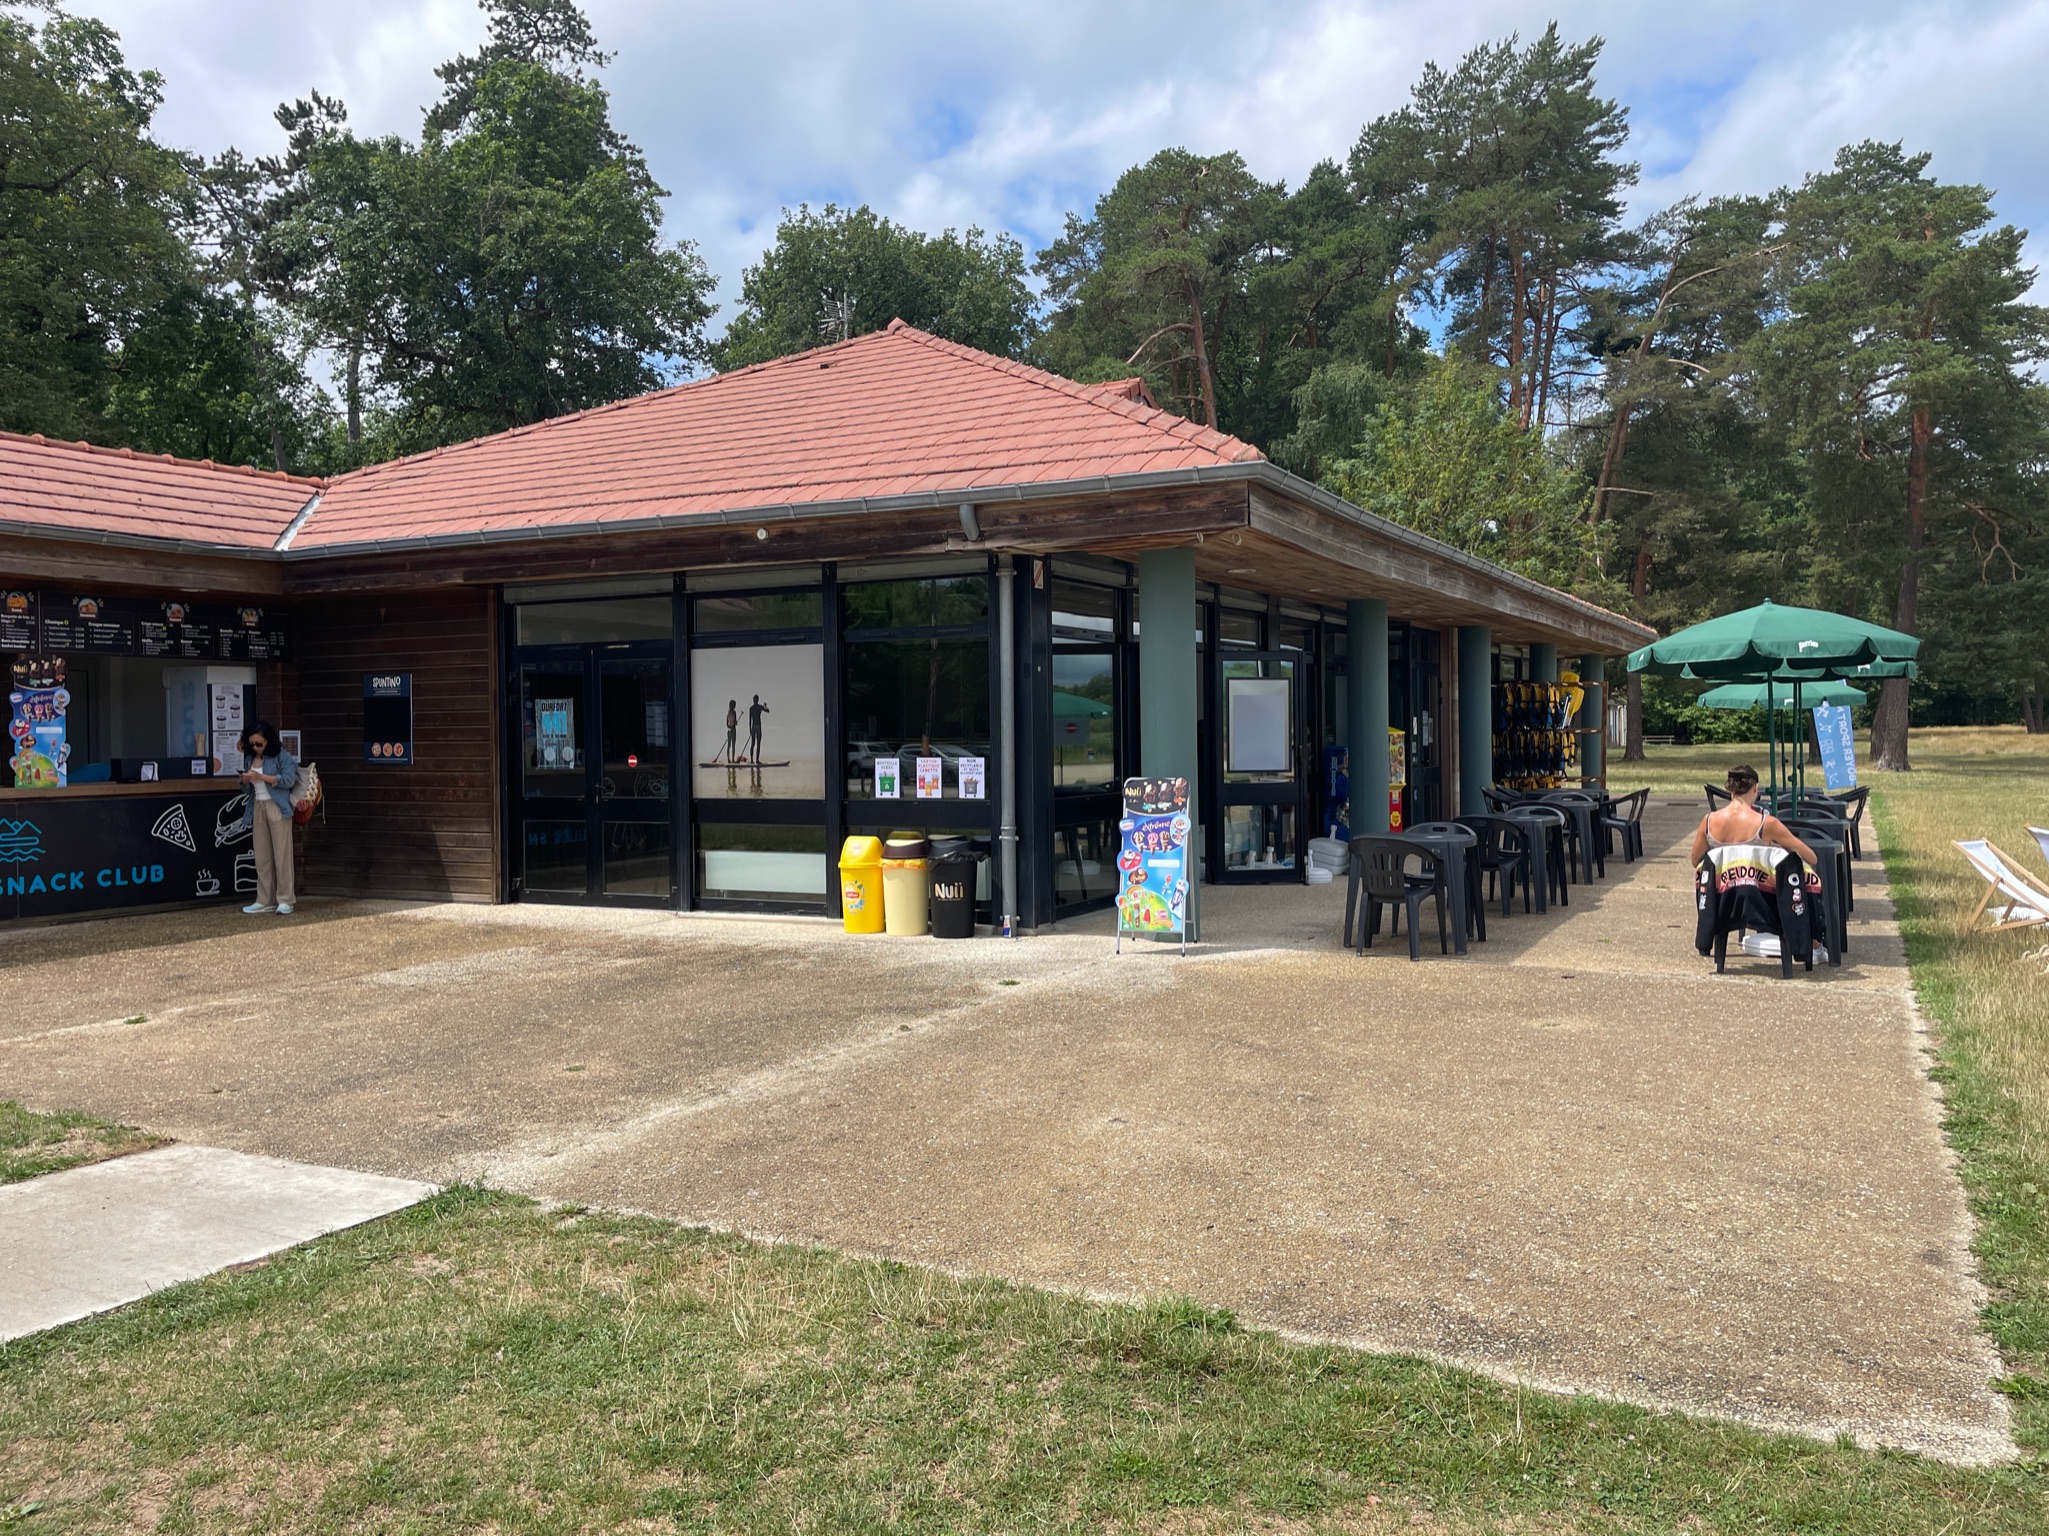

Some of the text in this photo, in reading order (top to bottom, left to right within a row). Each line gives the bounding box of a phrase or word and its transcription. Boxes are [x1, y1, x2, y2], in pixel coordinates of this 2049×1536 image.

[372, 675, 401, 688] SPUNTINO
[0, 864, 165, 897] NACK CLUB
[934, 882, 964, 898] Nuii
